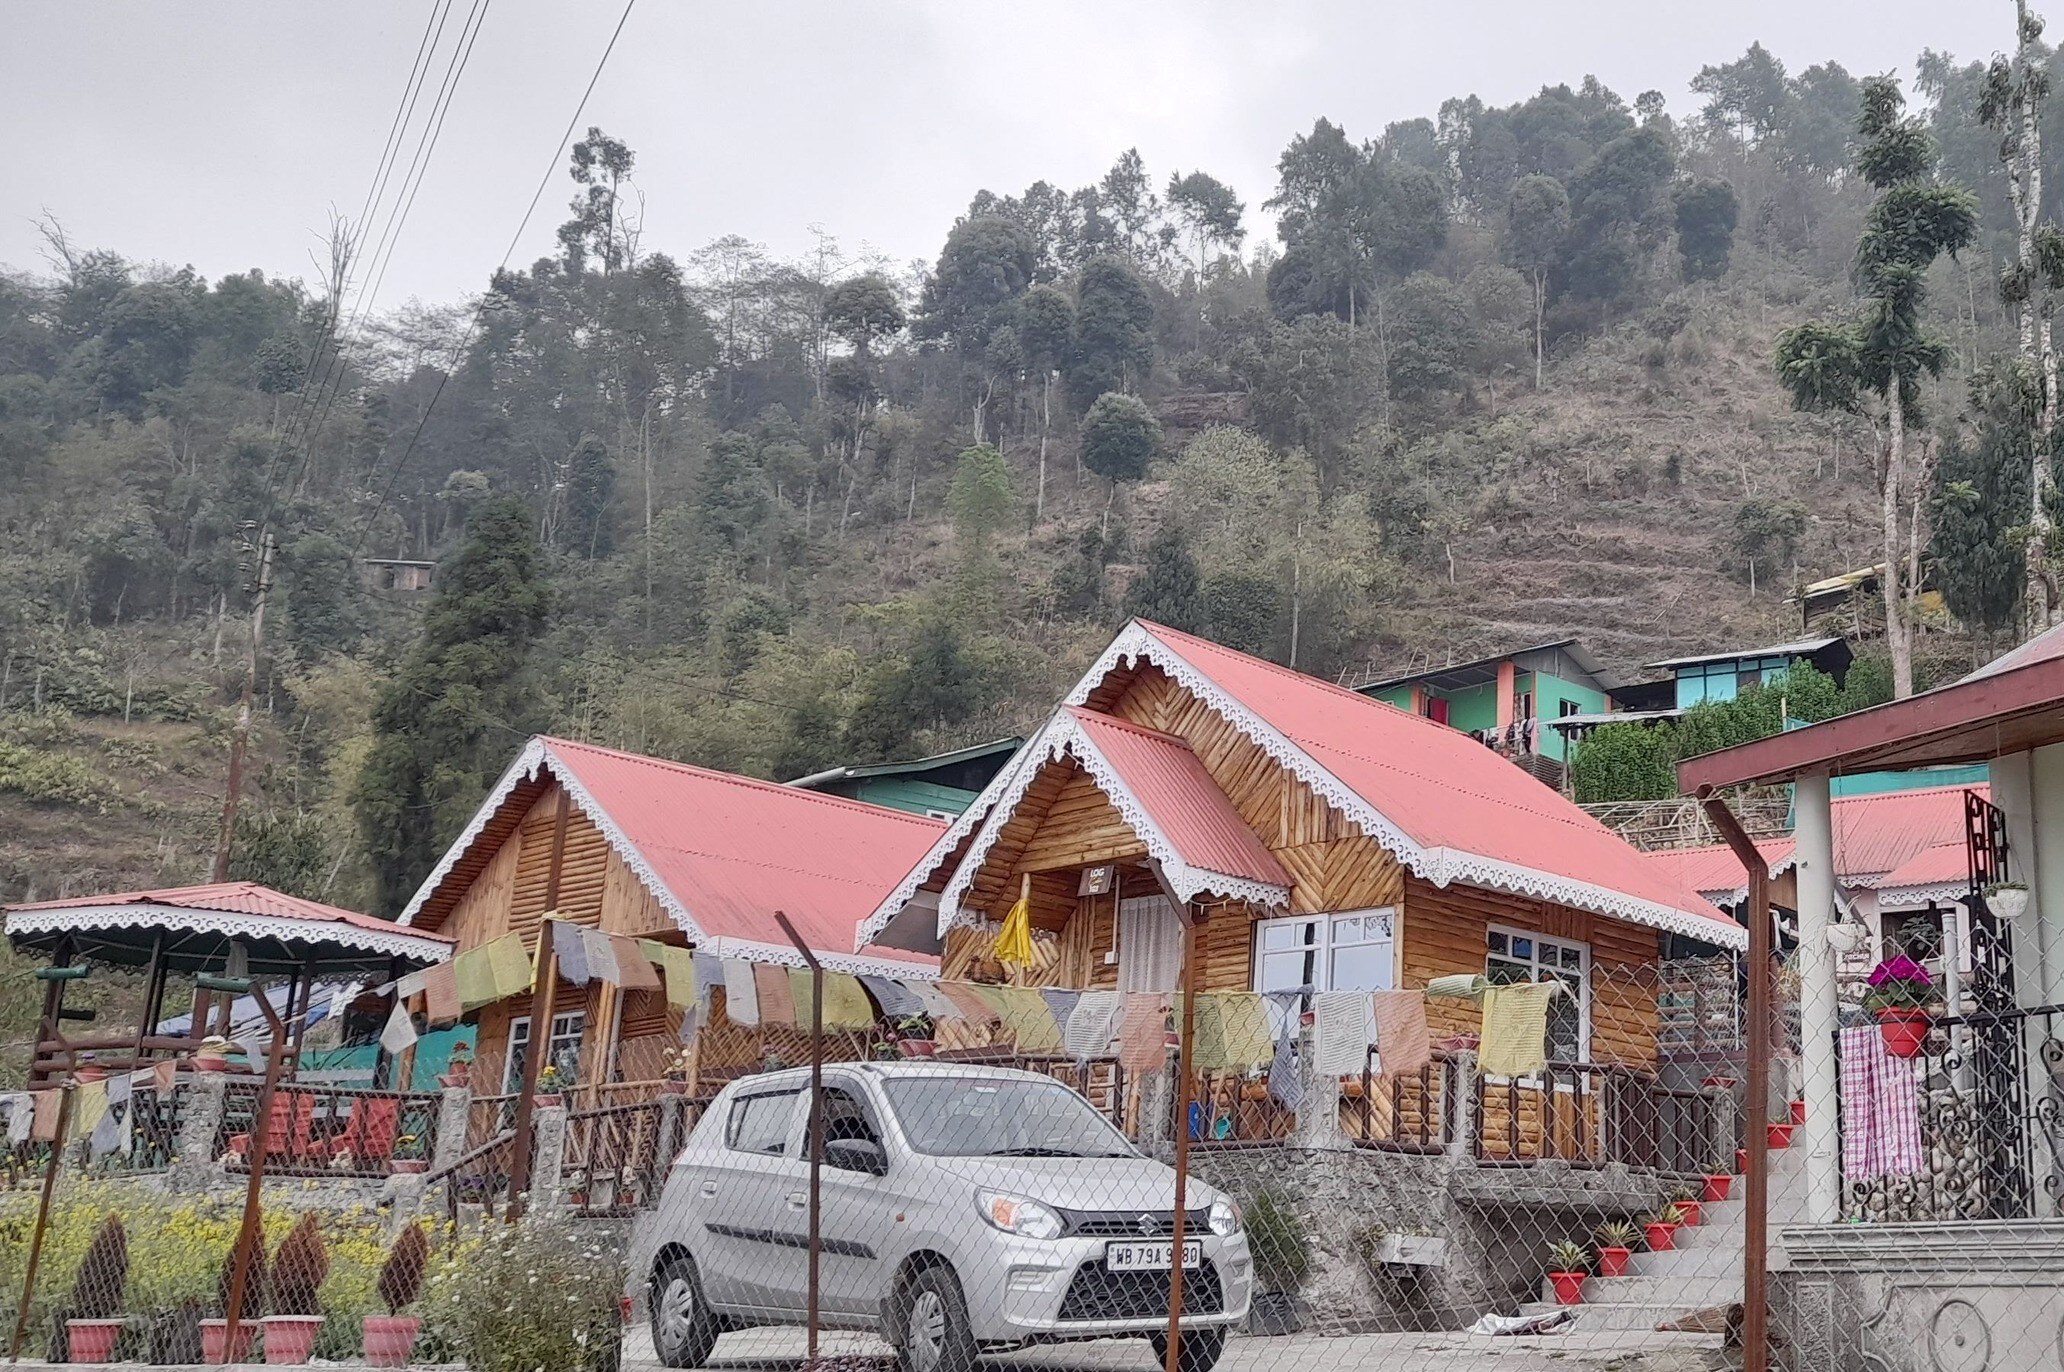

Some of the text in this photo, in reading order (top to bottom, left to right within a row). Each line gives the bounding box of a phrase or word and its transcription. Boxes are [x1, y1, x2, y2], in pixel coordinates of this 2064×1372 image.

[1090, 868, 1105, 878] LOG
[1116, 1247, 1198, 1265] WB 79A 980
